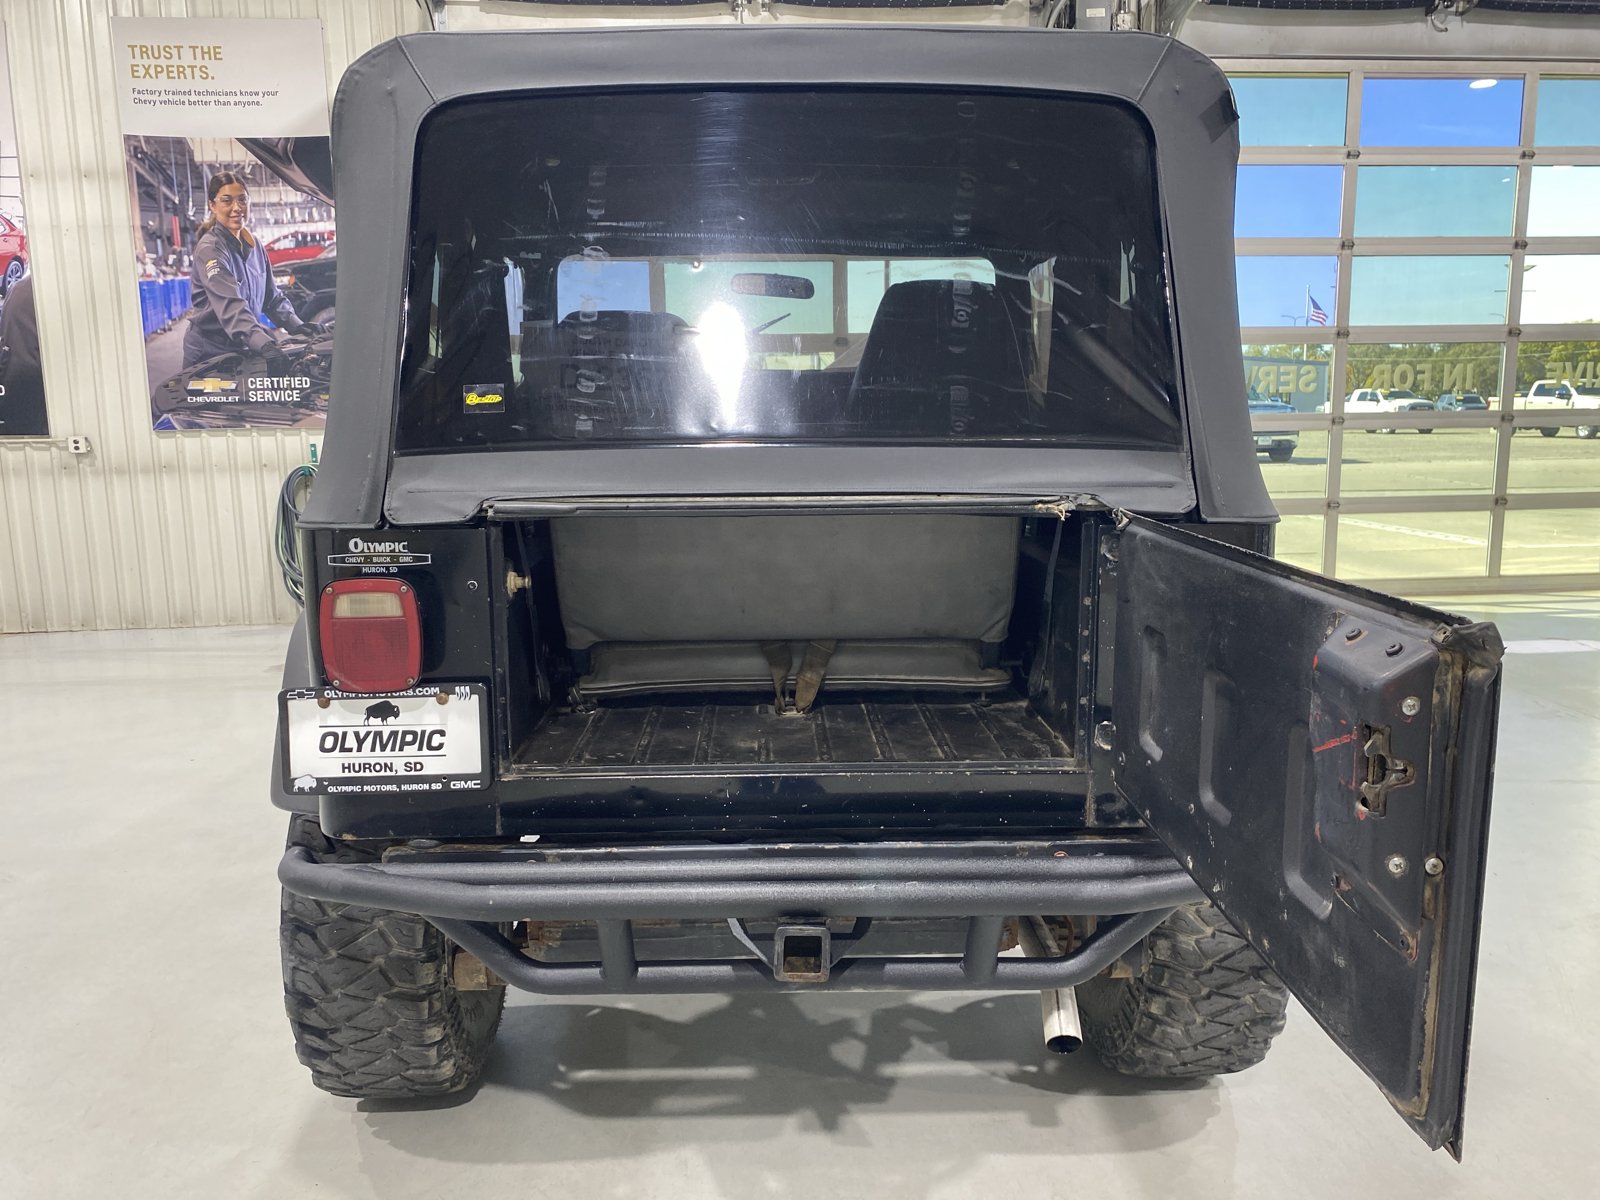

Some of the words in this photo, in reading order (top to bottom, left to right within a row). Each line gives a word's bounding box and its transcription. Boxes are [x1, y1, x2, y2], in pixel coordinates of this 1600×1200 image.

[127, 45, 184, 60] TRUST
[188, 46, 223, 60] THE
[130, 64, 215, 80] EXPERTS.
[131, 87, 162, 97] Factory
[194, 89, 238, 97] technicians
[240, 89, 260, 97] know
[262, 90, 279, 98] your
[133, 97, 157, 107] Chevy
[159, 98, 186, 106] vehicle
[233, 100, 263, 108] anyone.
[247, 376, 311, 389] CERTIFIED
[187, 395, 240, 403] CHEVROLET
[248, 389, 301, 402] SERVICE
[348, 537, 409, 553] OLYMPIC
[319, 729, 446, 753] OLYMPIC
[341, 762, 399, 775] HURON,
[404, 762, 424, 772] SD
[327, 784, 362, 793] OLYMPIC
[363, 783, 400, 792] MOTORS,
[401, 783, 430, 791] HURON
[431, 782, 443, 790] SD
[450, 780, 481, 789] GMC
